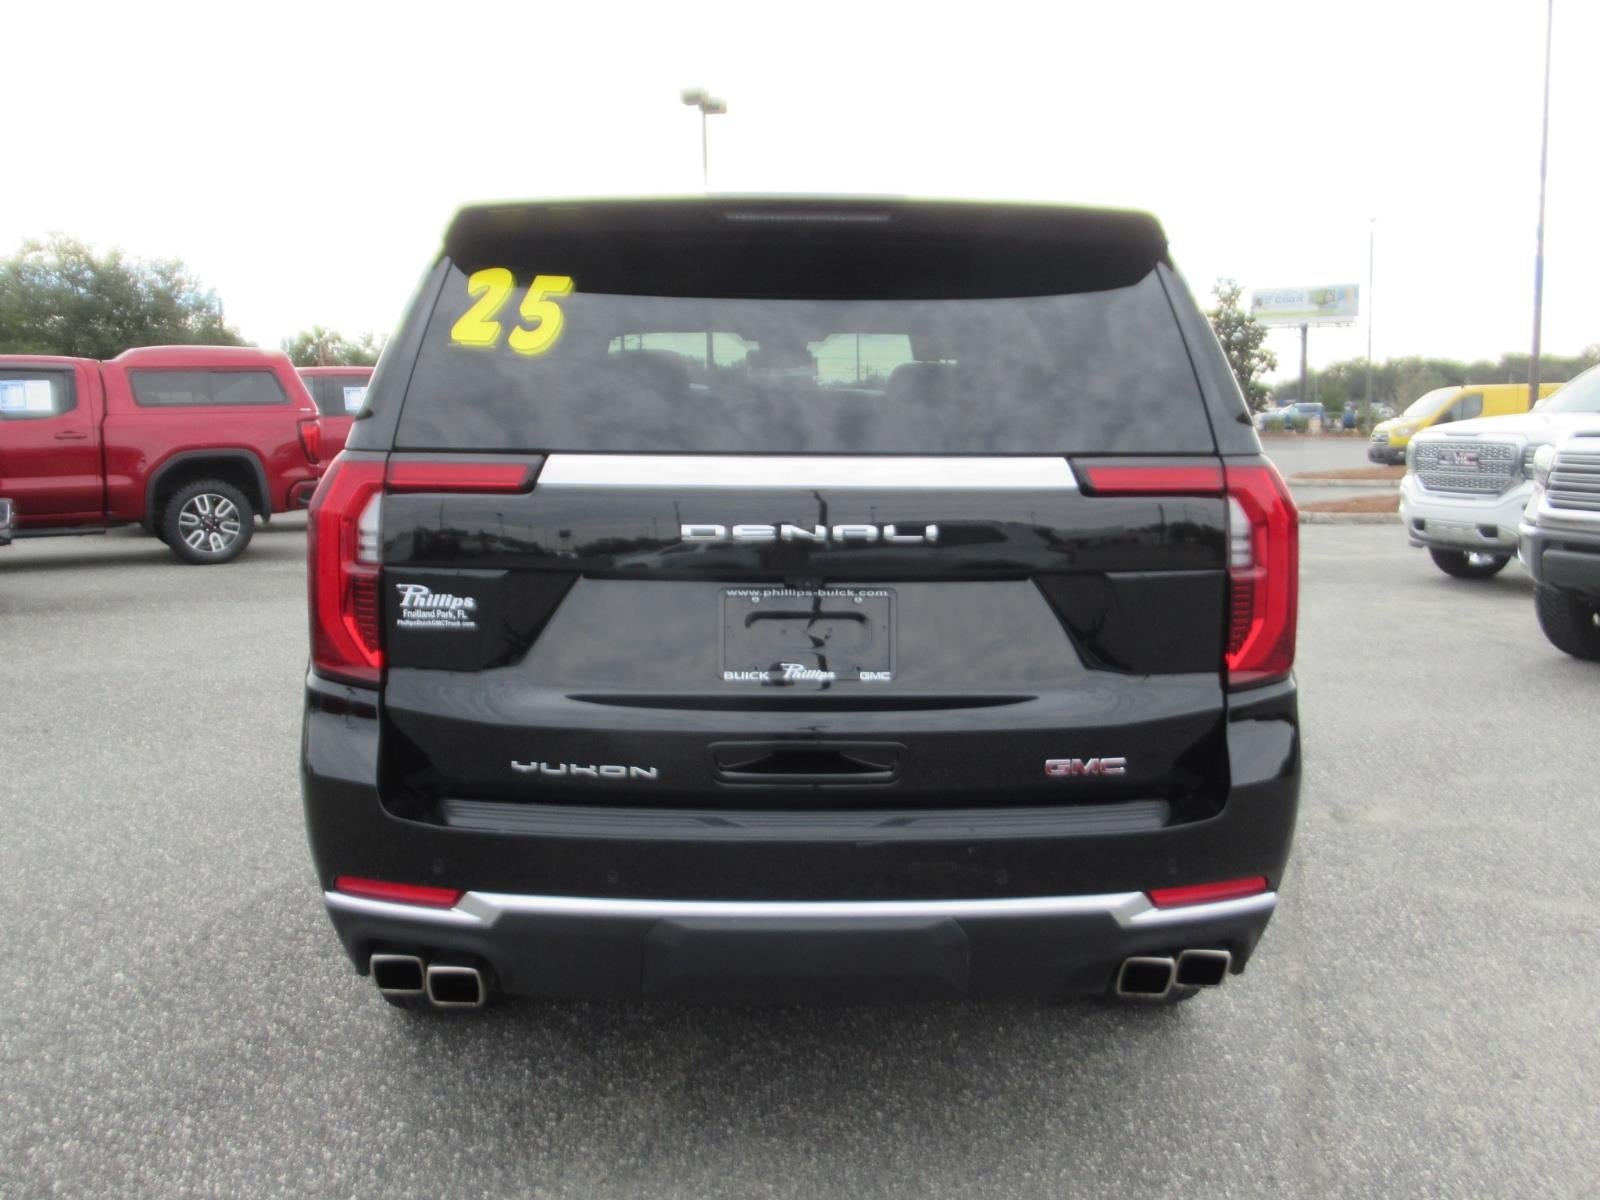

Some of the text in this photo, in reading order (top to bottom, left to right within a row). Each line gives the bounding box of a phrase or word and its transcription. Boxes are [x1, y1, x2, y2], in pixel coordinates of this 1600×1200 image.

[451, 267, 574, 355] 25
[681, 524, 938, 541] DENALI
[396, 583, 476, 609] Phillips
[726, 588, 889, 598] www.phillips-buick.com
[403, 608, 435, 619] Fruitland
[723, 662, 892, 682] BUICK Phillips GMC
[510, 760, 658, 779] YUKON
[1044, 757, 1127, 776] GMC
